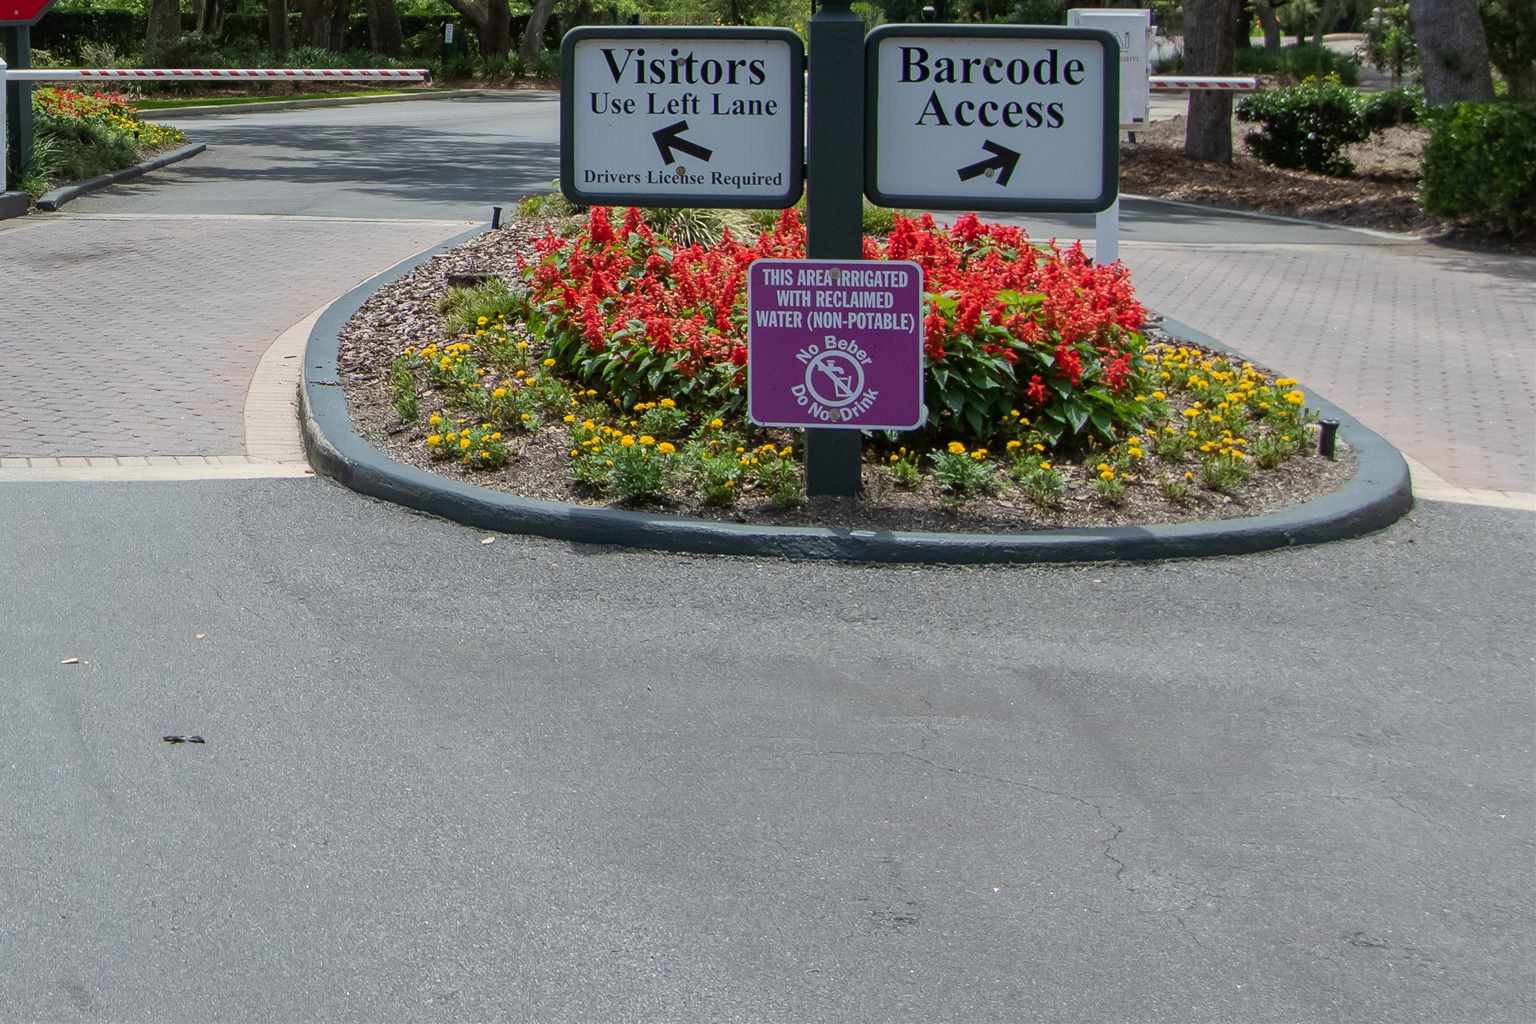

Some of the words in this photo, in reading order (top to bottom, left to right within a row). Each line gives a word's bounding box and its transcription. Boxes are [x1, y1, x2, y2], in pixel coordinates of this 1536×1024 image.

[600, 48, 766, 85] Visitors
[897, 46, 1085, 85] Barcode
[590, 91, 636, 114] Use
[647, 92, 701, 115] Left
[712, 92, 778, 116] Lane
[915, 89, 1064, 129] Access
[584, 169, 641, 184] Drivers
[647, 170, 705, 185] License
[711, 172, 782, 189] Required
[763, 268, 794, 286] THIS
[797, 269, 833, 286] AREA
[776, 290, 812, 307] WITH
[816, 291, 894, 308] RECLAIMED
[756, 310, 803, 328] WATER
[807, 311, 915, 334] (NON-POTABLE)
[795, 344, 819, 365] No
[824, 335, 872, 365] Beber
[791, 384, 809, 406] Do
[808, 403, 837, 421] No
[839, 388, 880, 422] Drink
